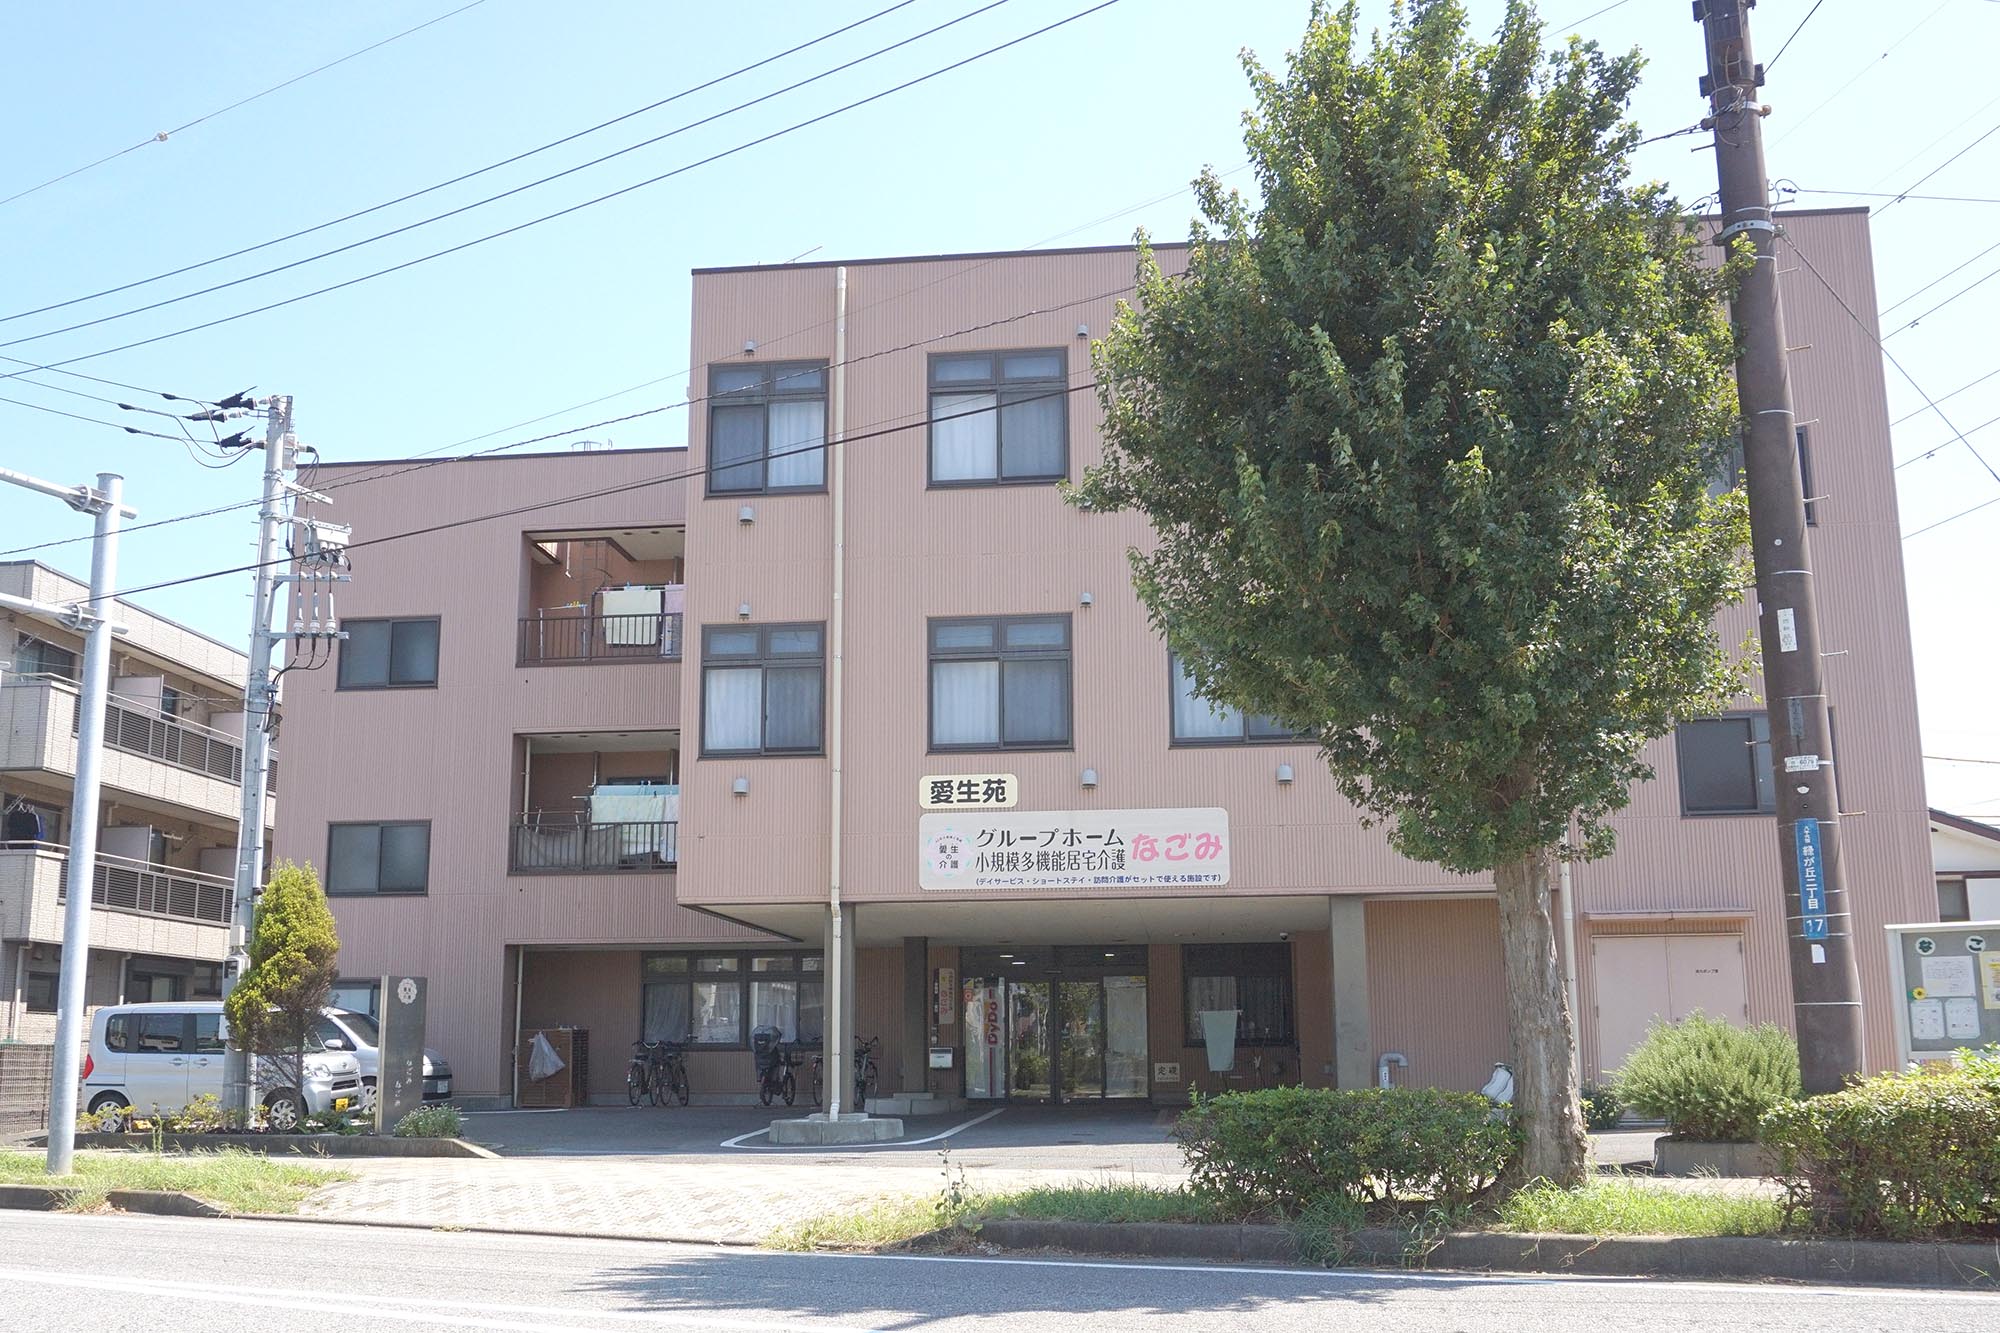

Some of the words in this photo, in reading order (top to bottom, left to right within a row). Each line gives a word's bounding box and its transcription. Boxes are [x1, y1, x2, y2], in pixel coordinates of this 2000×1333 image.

[930, 779, 1007, 804] 愛生苑
[976, 828, 1124, 847] グループホーム
[1132, 833, 1223, 861] なごみ
[975, 848, 1126, 872] 小規模多機能居宅介護
[1802, 845, 1818, 909] 緑が丘二丁目
[1806, 919, 1823, 932] 17
[988, 1001, 1000, 1045] DyDo
